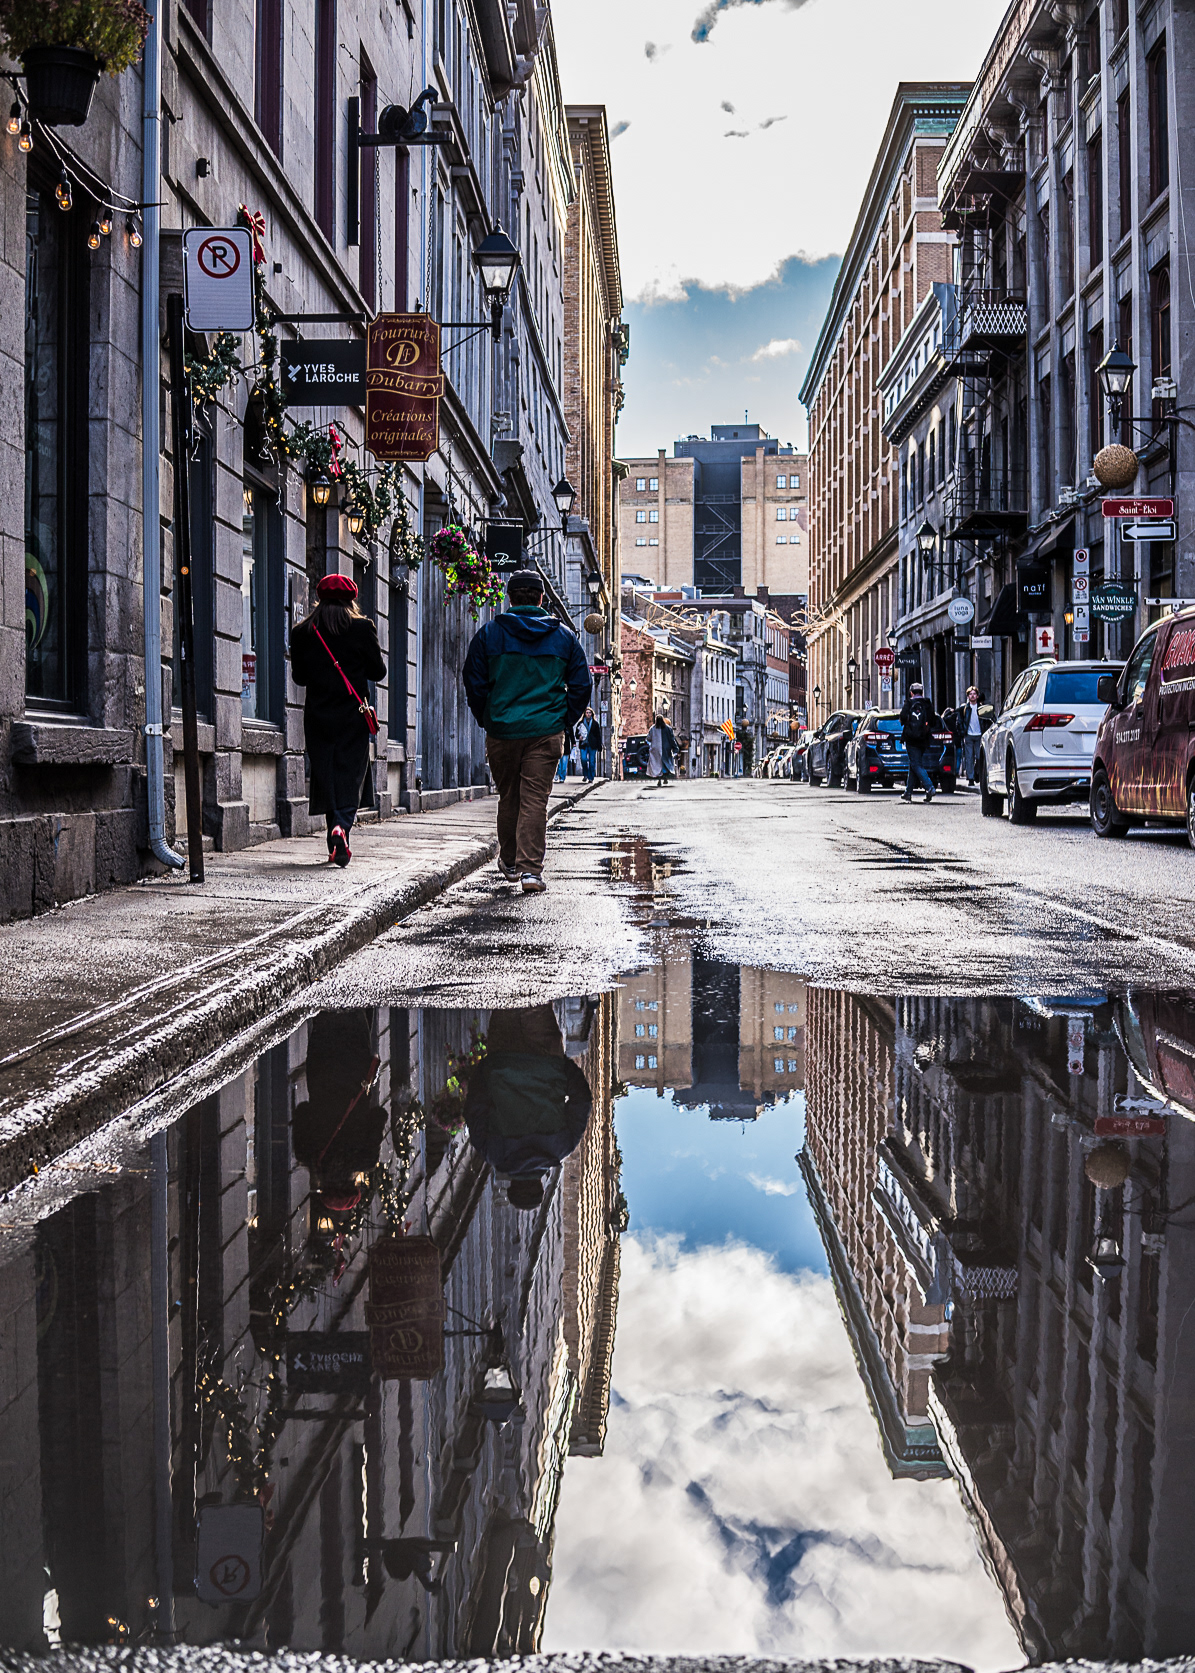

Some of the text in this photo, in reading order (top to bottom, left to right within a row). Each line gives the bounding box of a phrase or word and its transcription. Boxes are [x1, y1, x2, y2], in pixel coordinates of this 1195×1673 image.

[371, 326, 436, 344] Fourrures
[304, 364, 336, 372] YVES
[305, 373, 360, 383] LAROCHE
[367, 373, 439, 395] Dubarry
[371, 408, 432, 422] Créations
[370, 427, 432, 445] originales
[1023, 583, 1046, 592] naïf
[1092, 595, 1105, 604] VAN
[1107, 595, 1134, 604] WINKLE
[875, 653, 894, 661] ARRÊT
